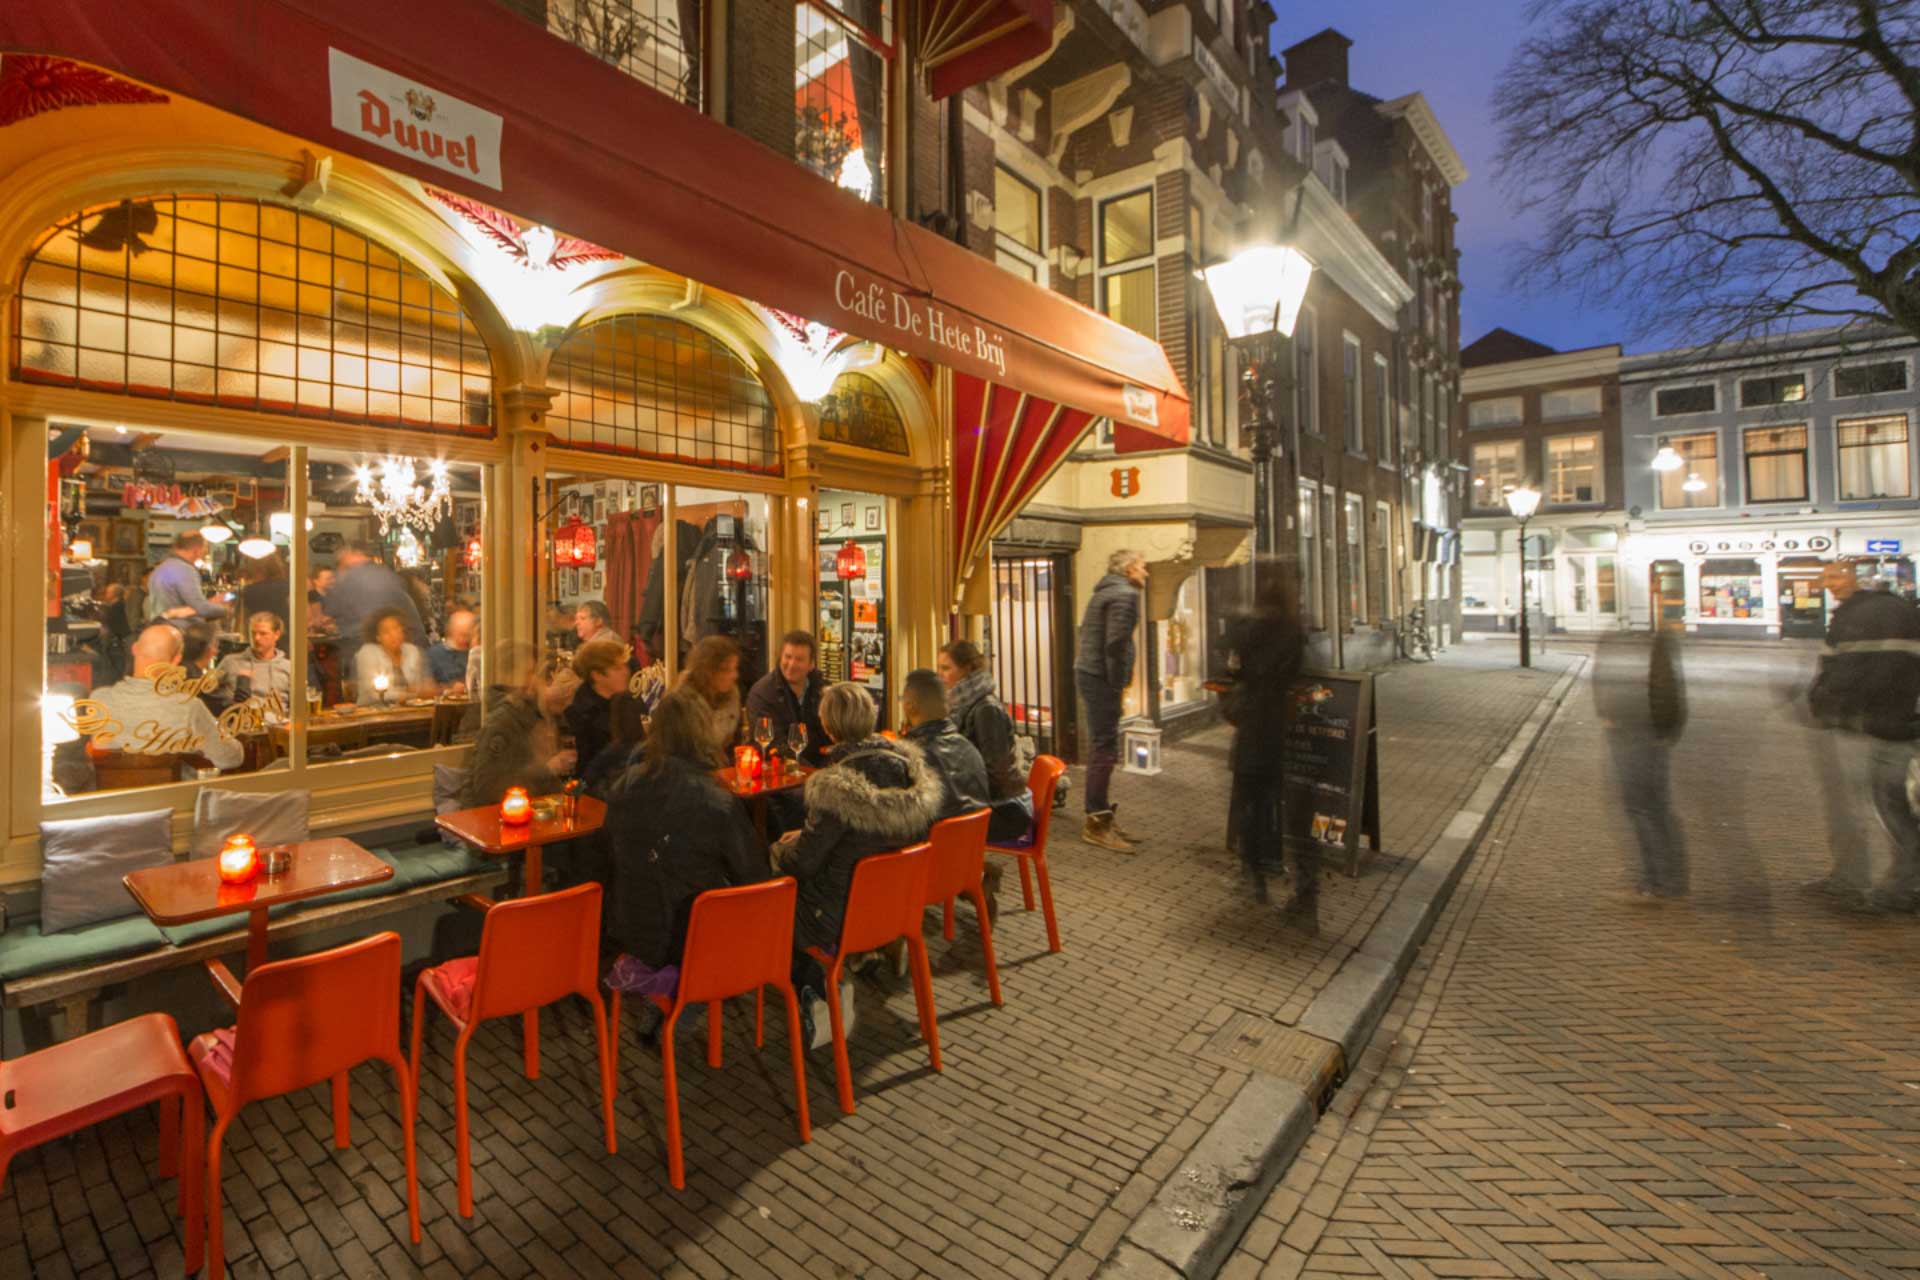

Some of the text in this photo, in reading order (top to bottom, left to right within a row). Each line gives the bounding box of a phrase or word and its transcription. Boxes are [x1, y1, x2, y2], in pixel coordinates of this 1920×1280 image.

[357, 89, 480, 175] Duvel
[834, 270, 1006, 377] Café De Hete Brij
[144, 662, 224, 704] Café
[122, 719, 206, 756] Hete
